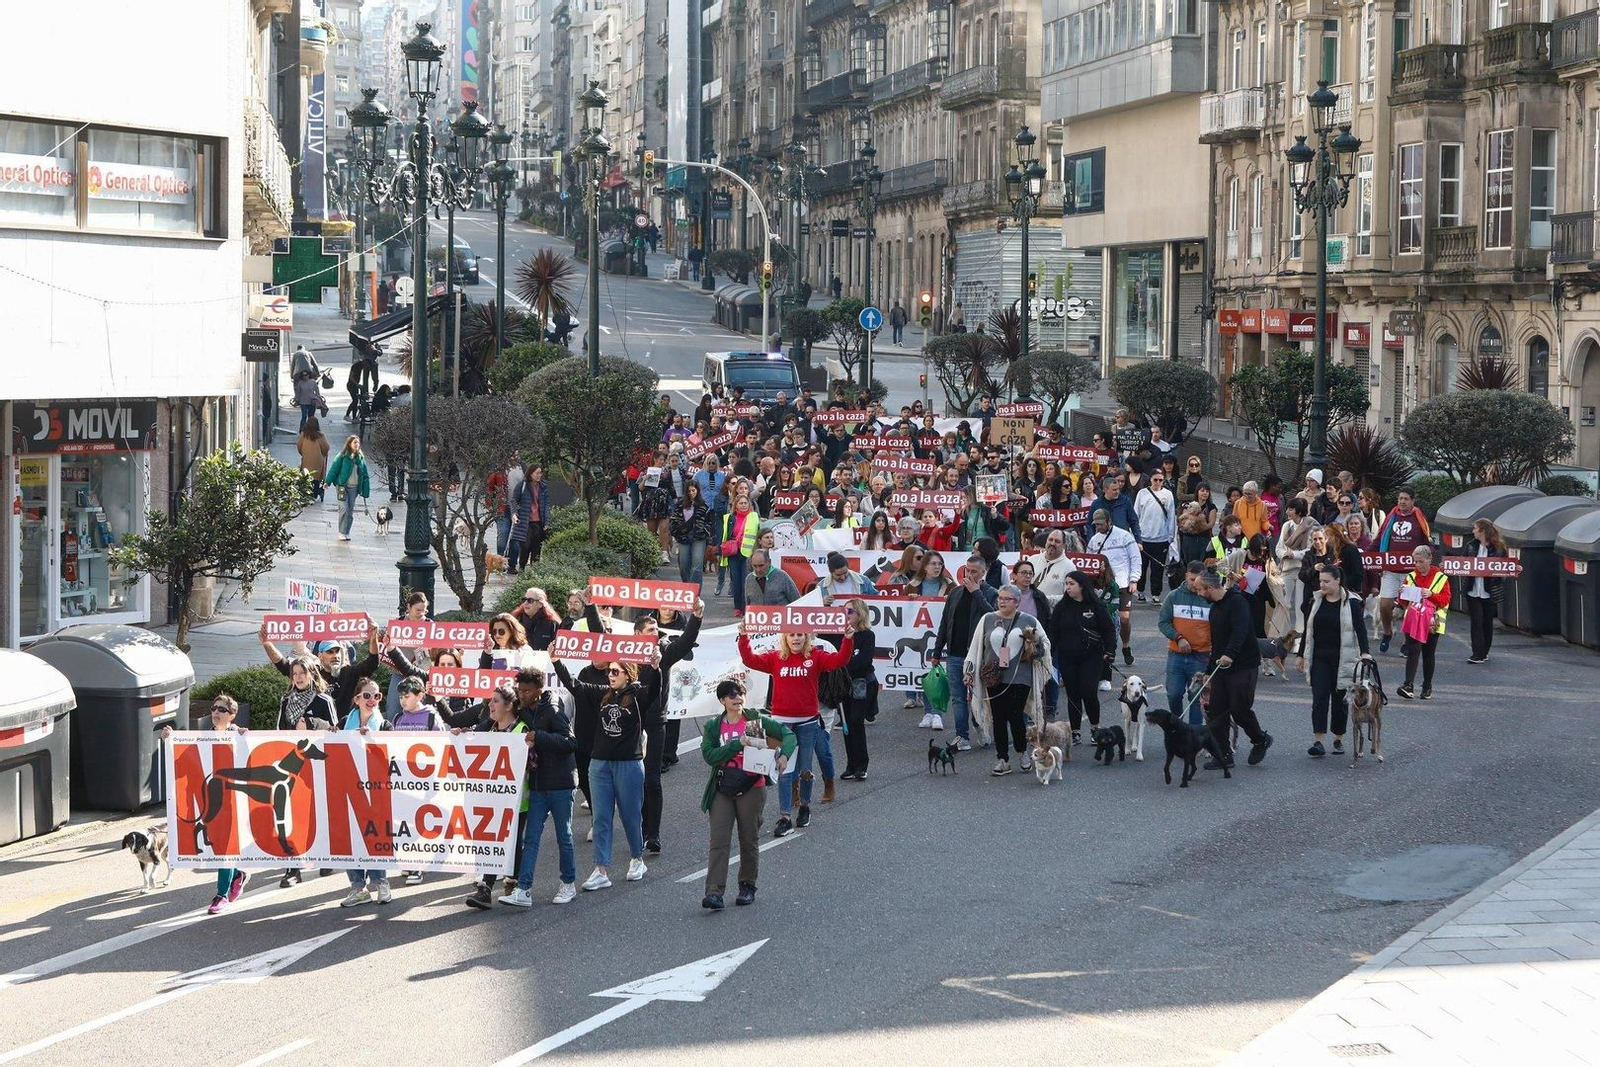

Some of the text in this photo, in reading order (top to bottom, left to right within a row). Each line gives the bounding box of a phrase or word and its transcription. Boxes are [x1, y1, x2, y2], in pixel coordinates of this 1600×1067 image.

[308, 90, 323, 154] ATTICA
[34, 165, 73, 188] Optica
[106, 172, 189, 197] General Optica
[998, 406, 1009, 414] no
[1016, 404, 1024, 412] la
[1025, 404, 1042, 412] caza
[836, 412, 845, 420] la
[68, 407, 139, 440] MOVIL
[1002, 420, 1025, 428] NON
[686, 433, 732, 457] no a la caza
[855, 437, 909, 447] no a la caza
[923, 437, 931, 446] la
[1000, 435, 1027, 445] CAZA
[1061, 446, 1071, 456] la
[1073, 449, 1094, 458] caza
[688, 465, 700, 473] no
[875, 458, 933, 472] no a la caza
[777, 496, 838, 506] no a za
[892, 491, 960, 504] no a la caza
[1032, 512, 1046, 522] no
[1048, 513, 1055, 522] a
[1057, 511, 1066, 522] la
[1376, 555, 1382, 565] a
[1386, 553, 1396, 565] la
[1444, 558, 1516, 571] no a la caza
[592, 581, 694, 604] no a la caza
[745, 607, 846, 625] no a la caza
[870, 602, 934, 628] ON Á
[267, 616, 368, 634] no a la caza
[281, 633, 303, 641] perros
[390, 623, 485, 641] no a la caza
[555, 634, 653, 655] no a la caza
[567, 650, 589, 658] perros
[432, 672, 455, 687] no
[459, 674, 470, 688] a
[474, 670, 490, 689] la
[445, 687, 468, 695] perros
[387, 743, 516, 781] Á CAZA
[356, 781, 517, 794] CON GALGOS E OUTRAS RAZAS
[173, 741, 394, 857] NON
[363, 803, 514, 842] A LA CAZA
[374, 843, 505, 856] CON GALGOS Y OTRAS RA
